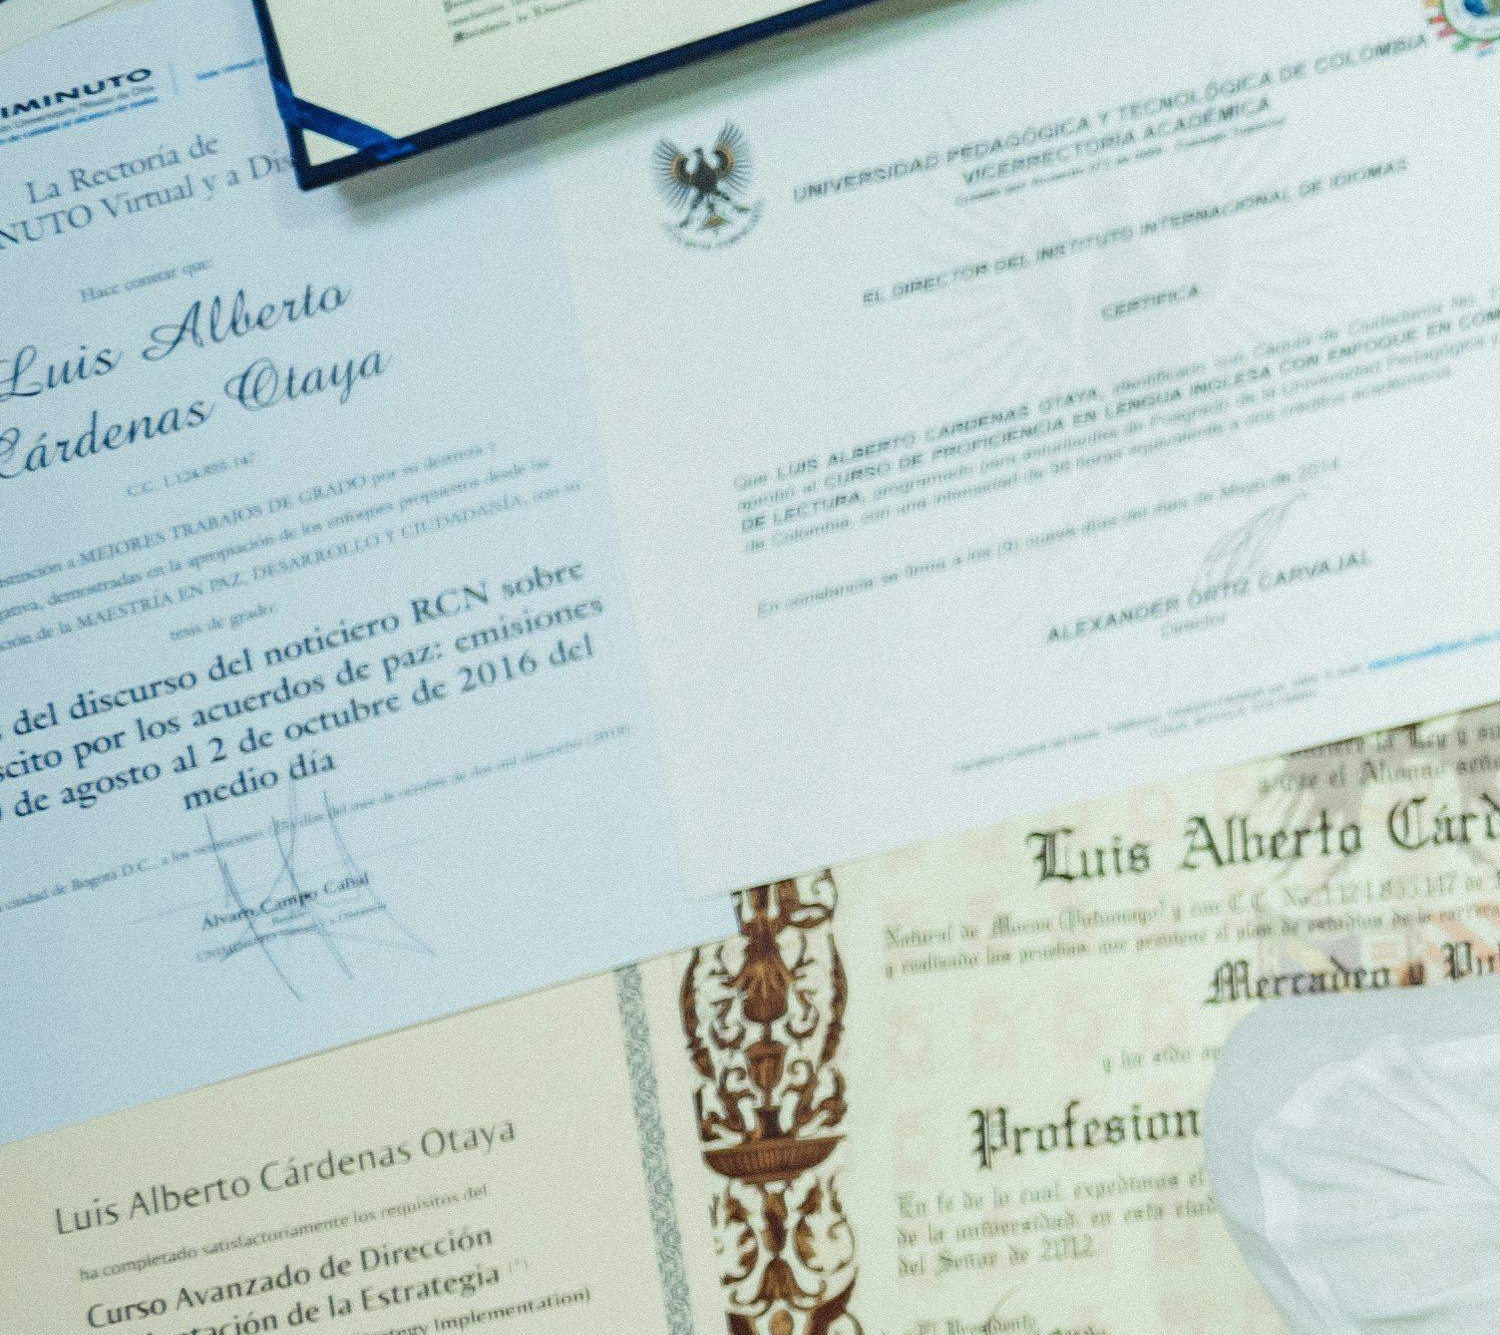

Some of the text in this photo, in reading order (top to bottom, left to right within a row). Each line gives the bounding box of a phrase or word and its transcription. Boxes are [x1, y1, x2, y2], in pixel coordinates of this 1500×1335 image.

[141, 282, 353, 361] Alberto
[263, 559, 584, 669] noticiero RCN sobre
[1025, 821, 1152, 887] Luis
[1184, 806, 1362, 874] Alberto
[53, 1117, 517, 1236] Luis Alberto Cárdenas Otaya
